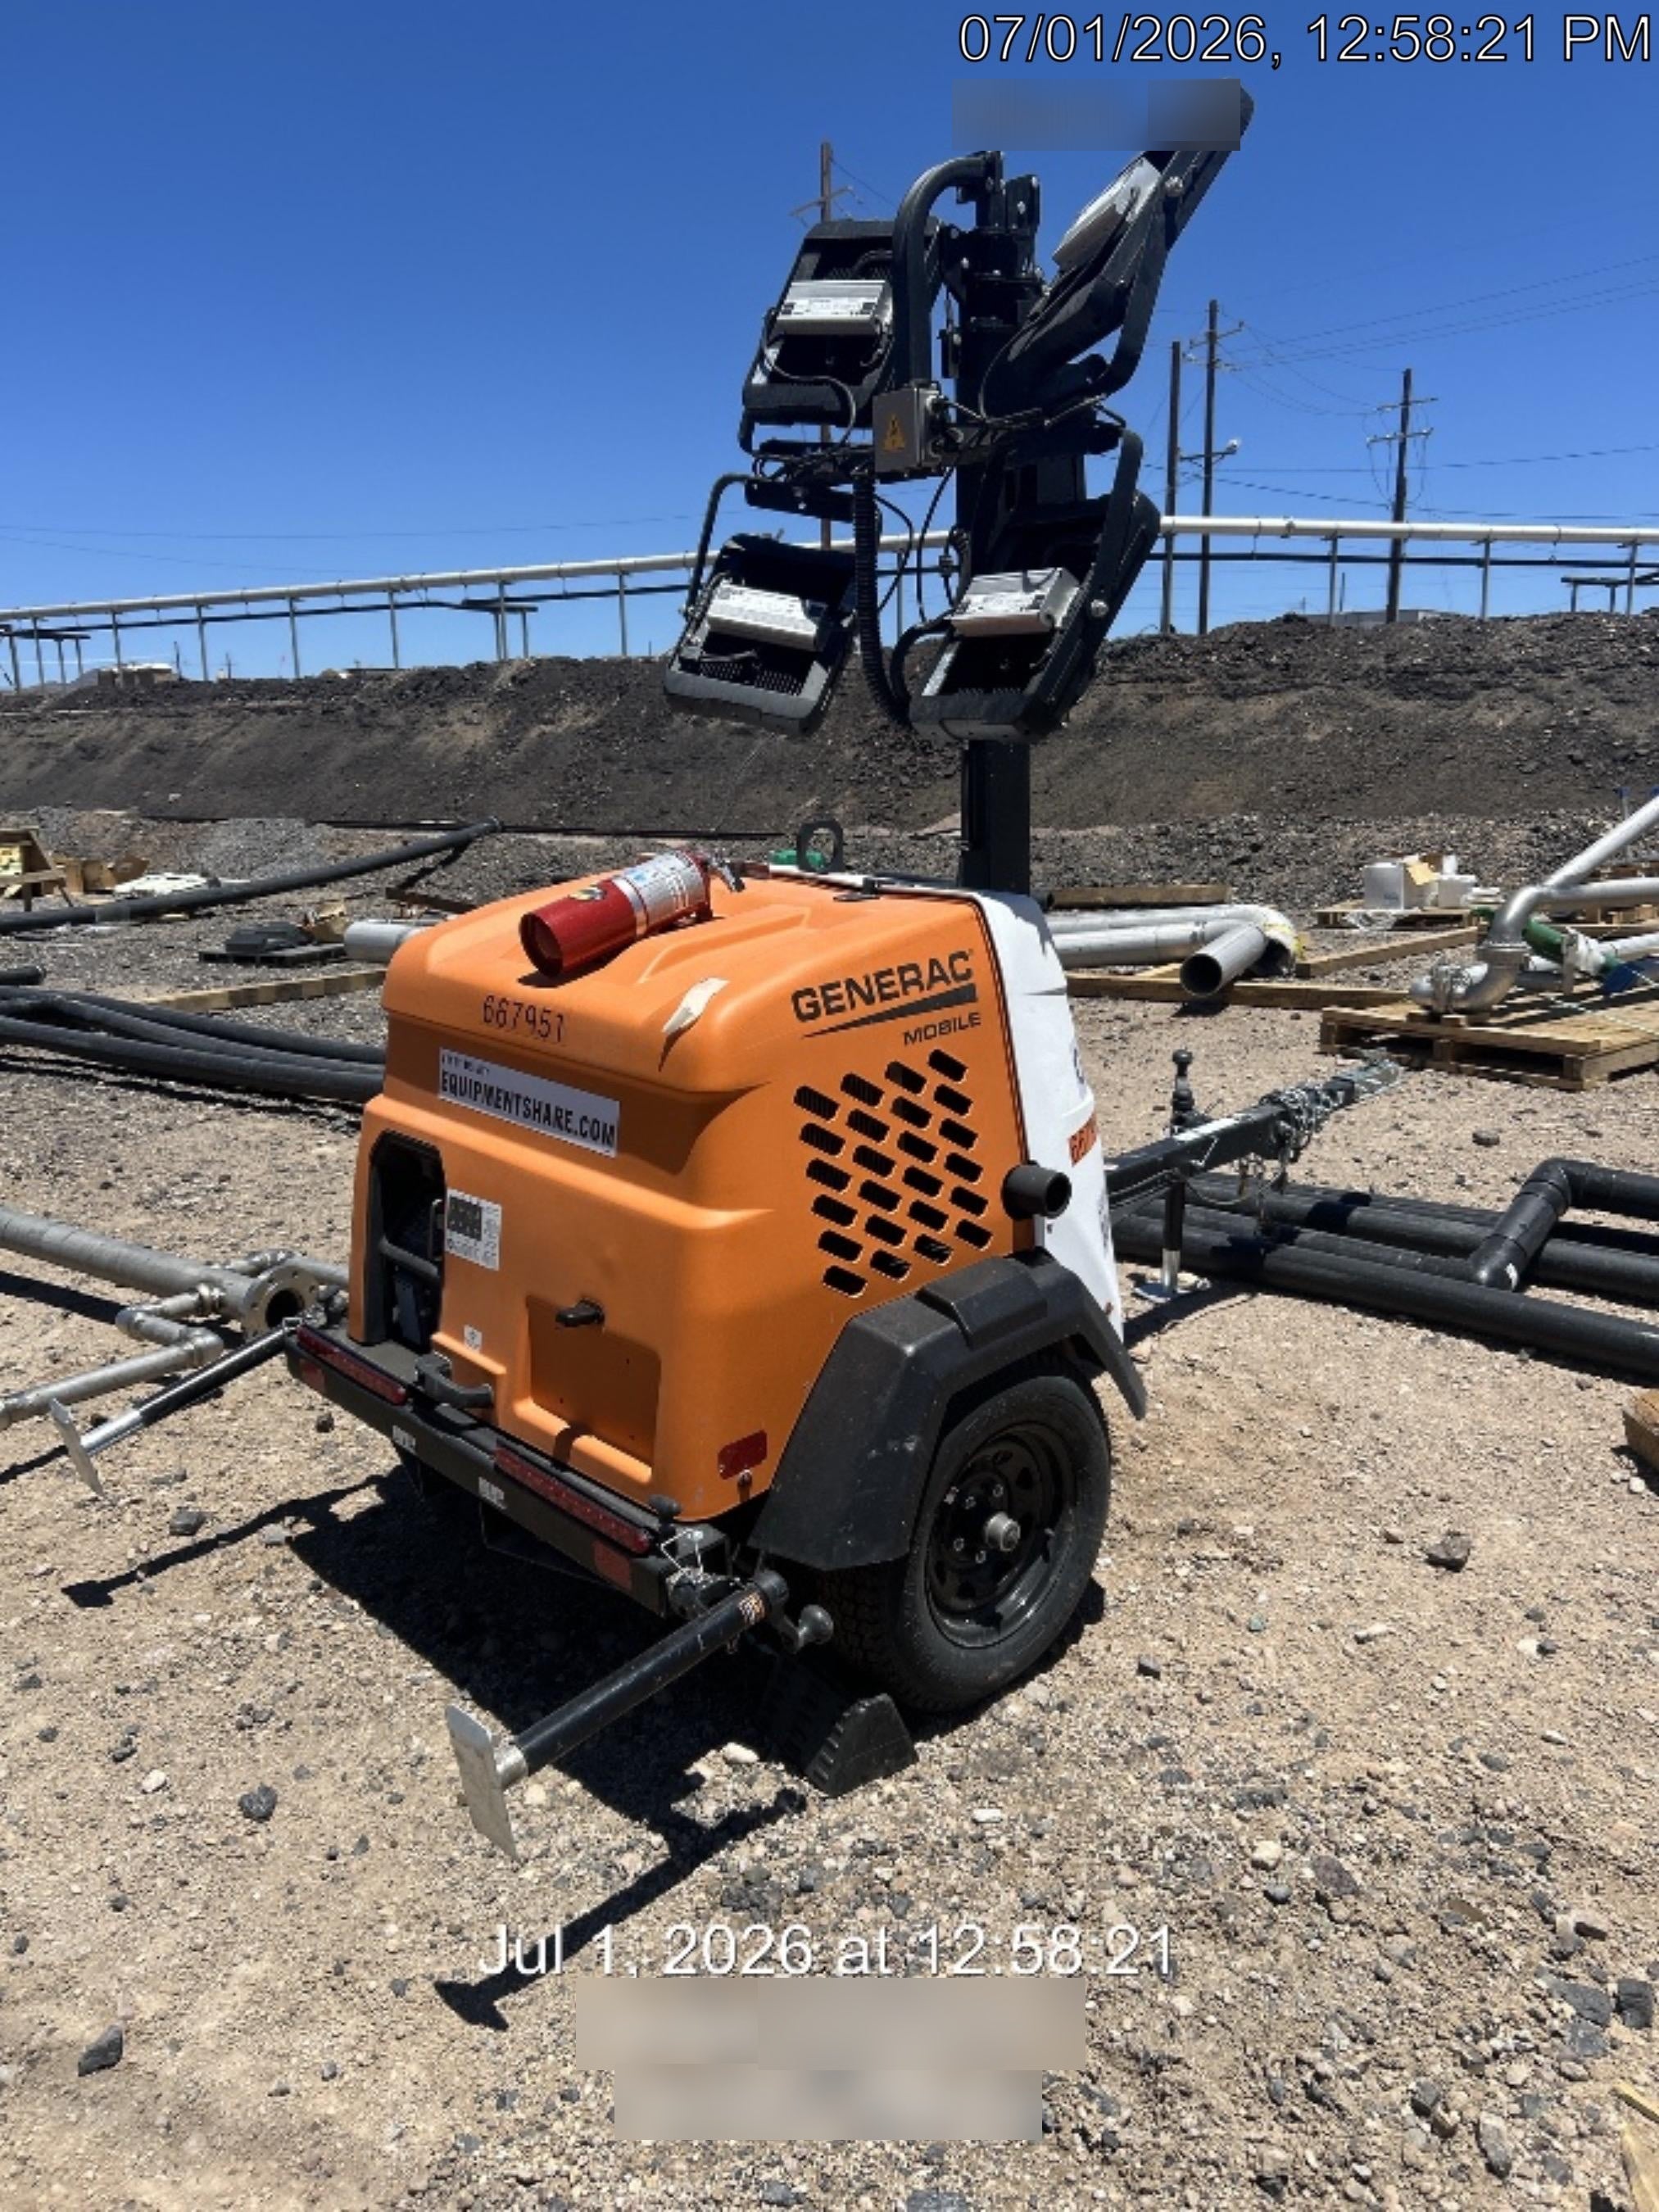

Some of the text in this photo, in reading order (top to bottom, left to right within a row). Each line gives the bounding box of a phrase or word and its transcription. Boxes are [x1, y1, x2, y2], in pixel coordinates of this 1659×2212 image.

[791, 950, 973, 1022] GENERAC
[903, 1012, 981, 1045] MOBILE
[441, 1070, 614, 1146] EQUIPMENTSHARE.COM
